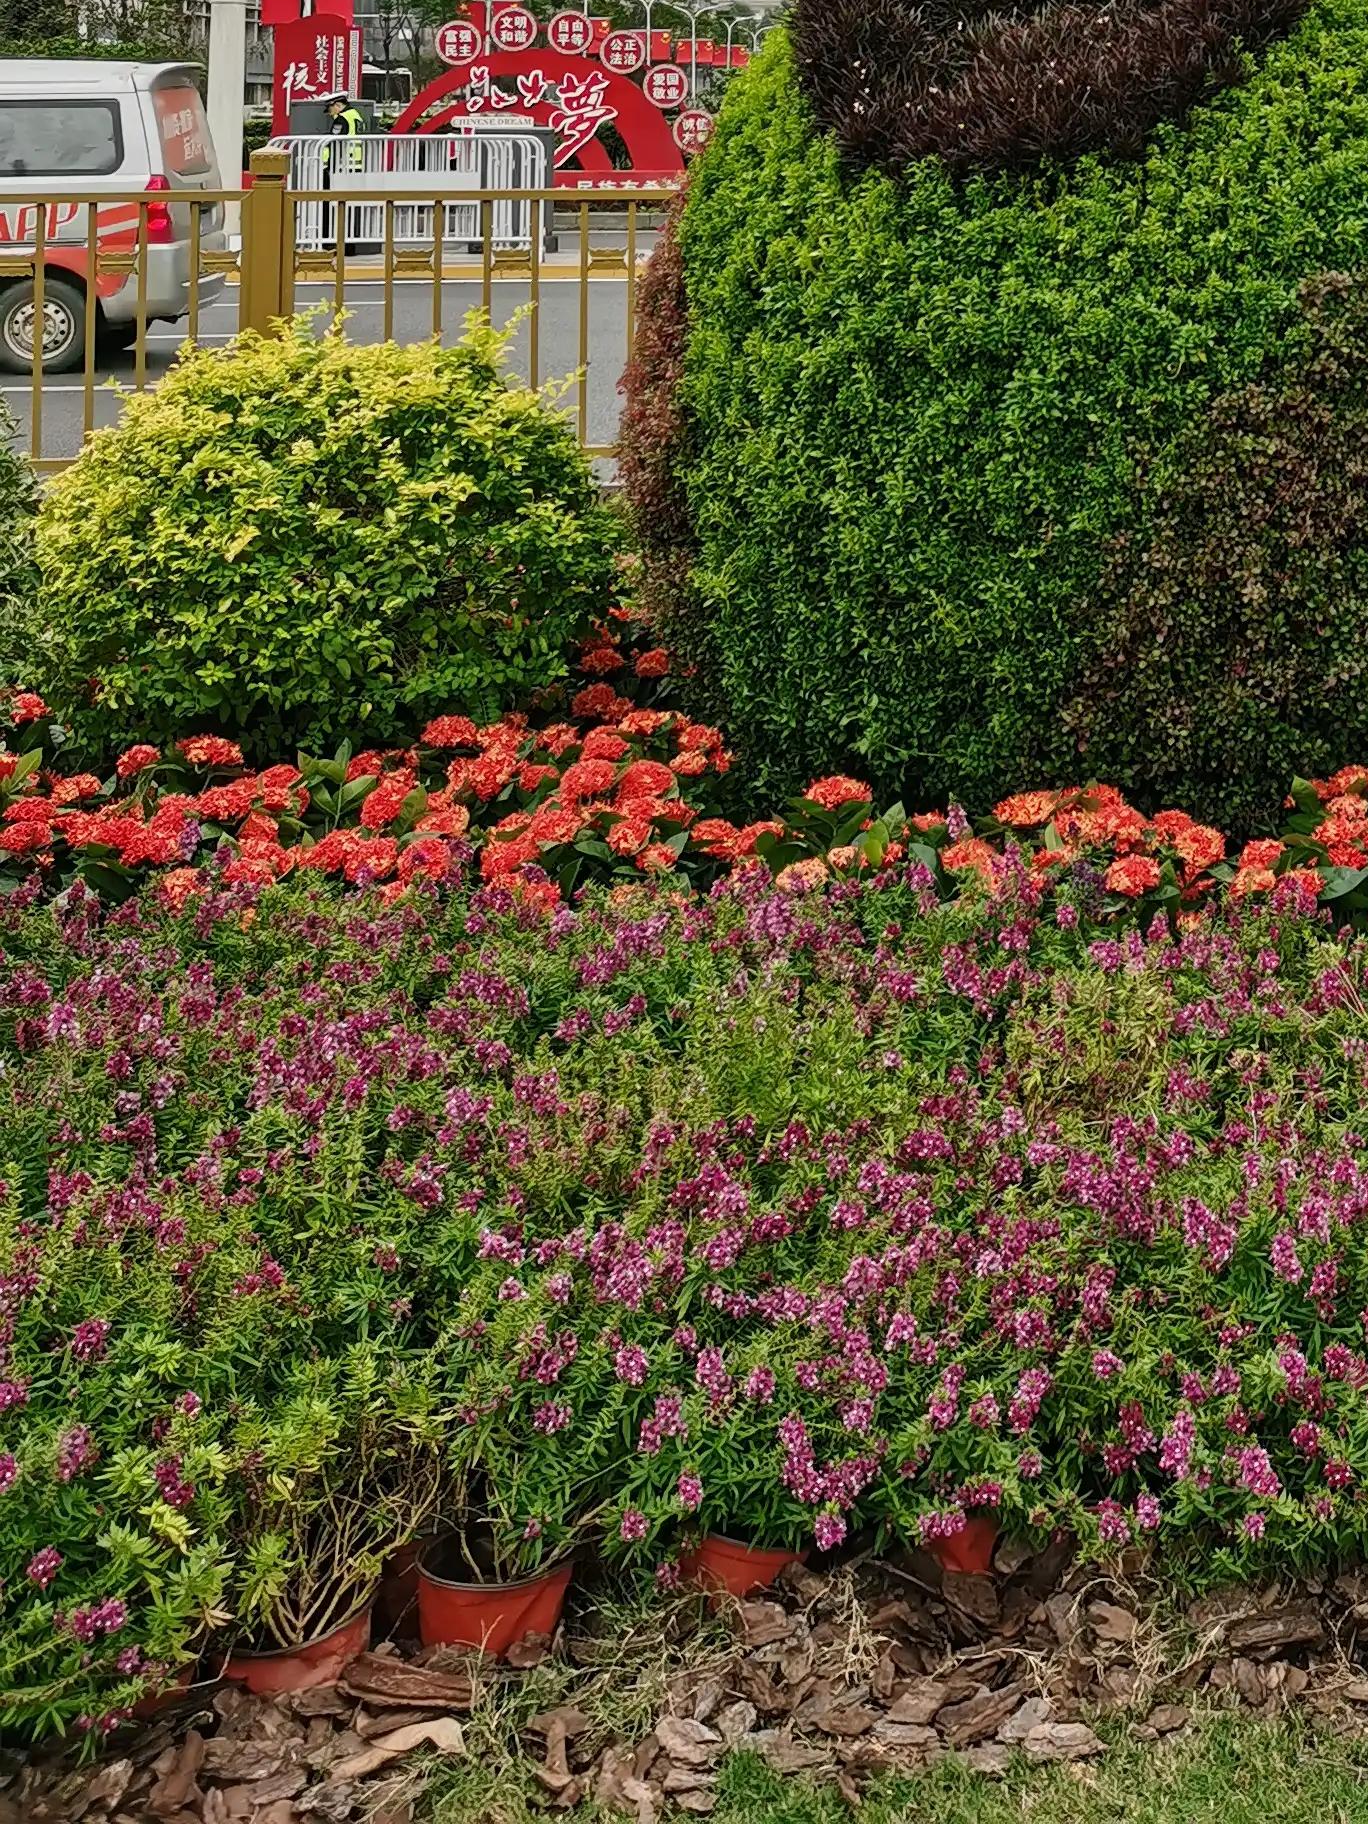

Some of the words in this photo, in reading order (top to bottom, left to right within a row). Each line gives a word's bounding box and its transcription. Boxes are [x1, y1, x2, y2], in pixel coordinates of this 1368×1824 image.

[500, 16, 528, 29] 文明
[445, 44, 473, 57] 民主
[610, 38, 638, 51] 公正
[609, 52, 638, 65] 法治
[497, 118, 532, 126] DREAM
